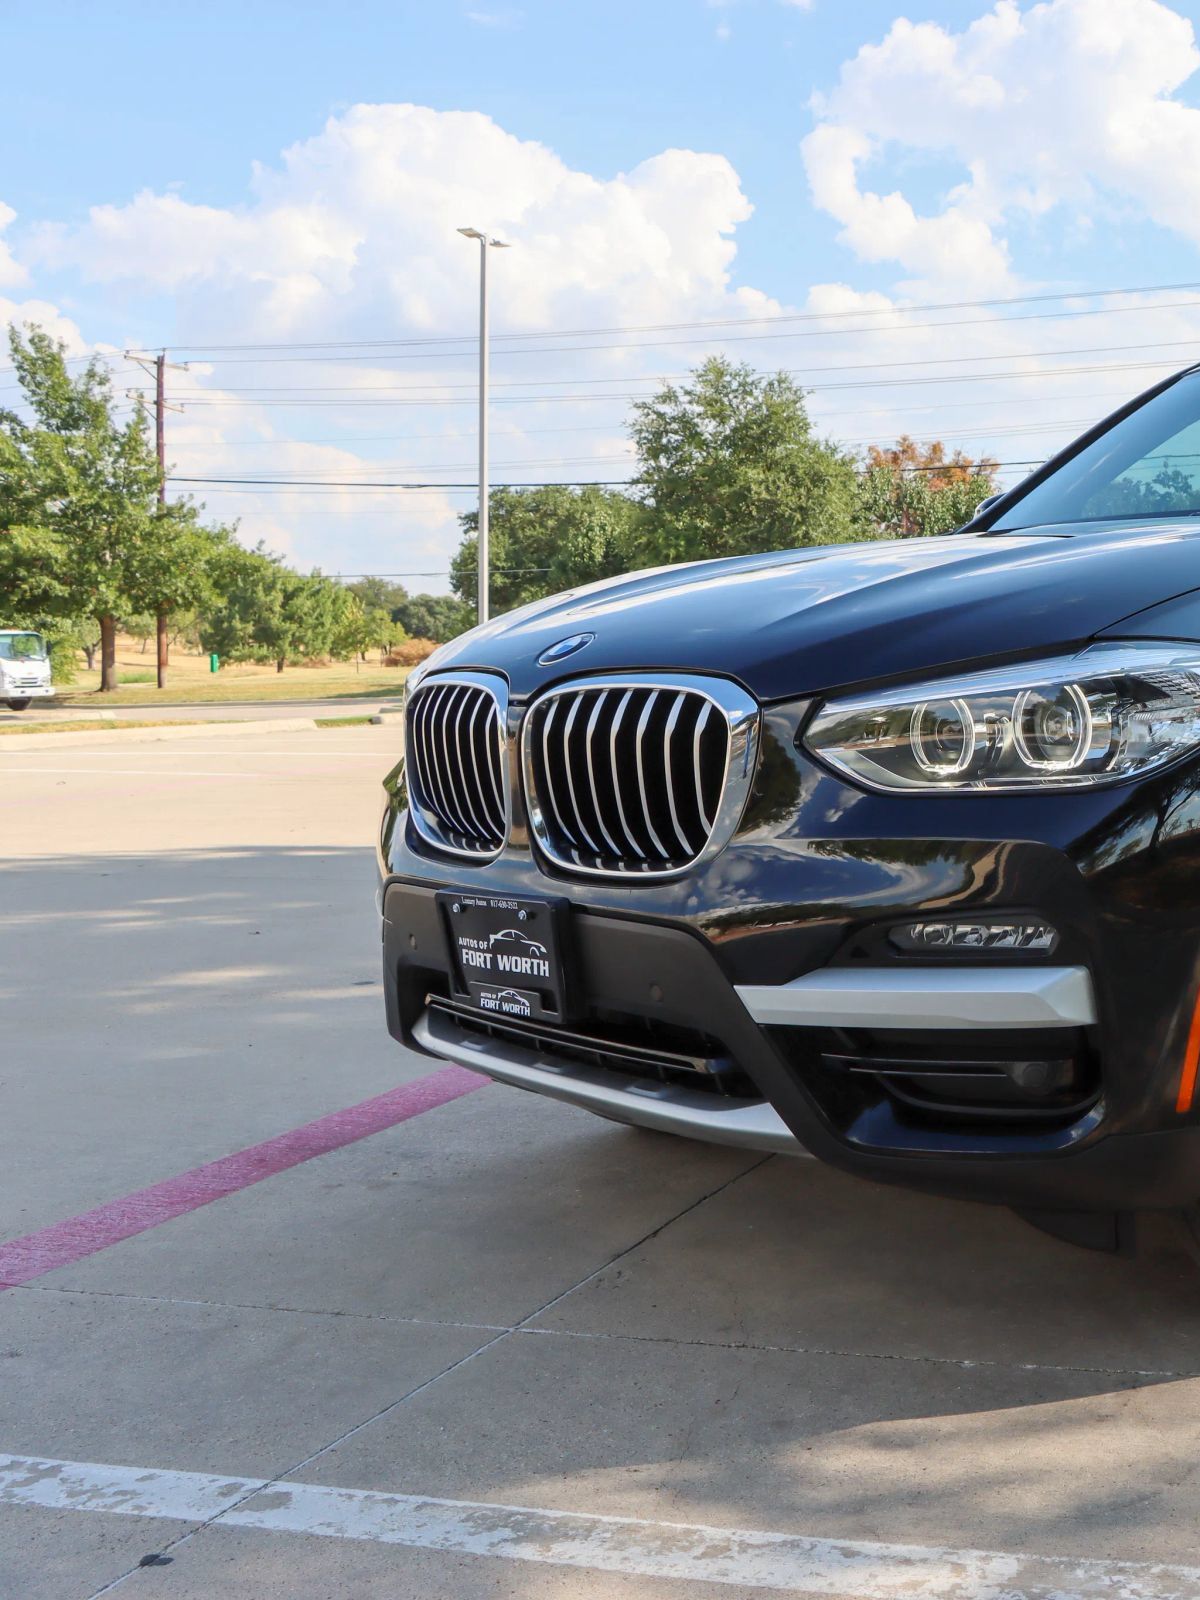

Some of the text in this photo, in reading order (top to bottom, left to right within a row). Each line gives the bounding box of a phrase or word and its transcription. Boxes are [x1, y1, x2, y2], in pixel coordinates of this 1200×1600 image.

[458, 937, 488, 950] AUTOS OF
[462, 948, 550, 977] FORT WORTH
[480, 998, 531, 1017] FORT WORTH
